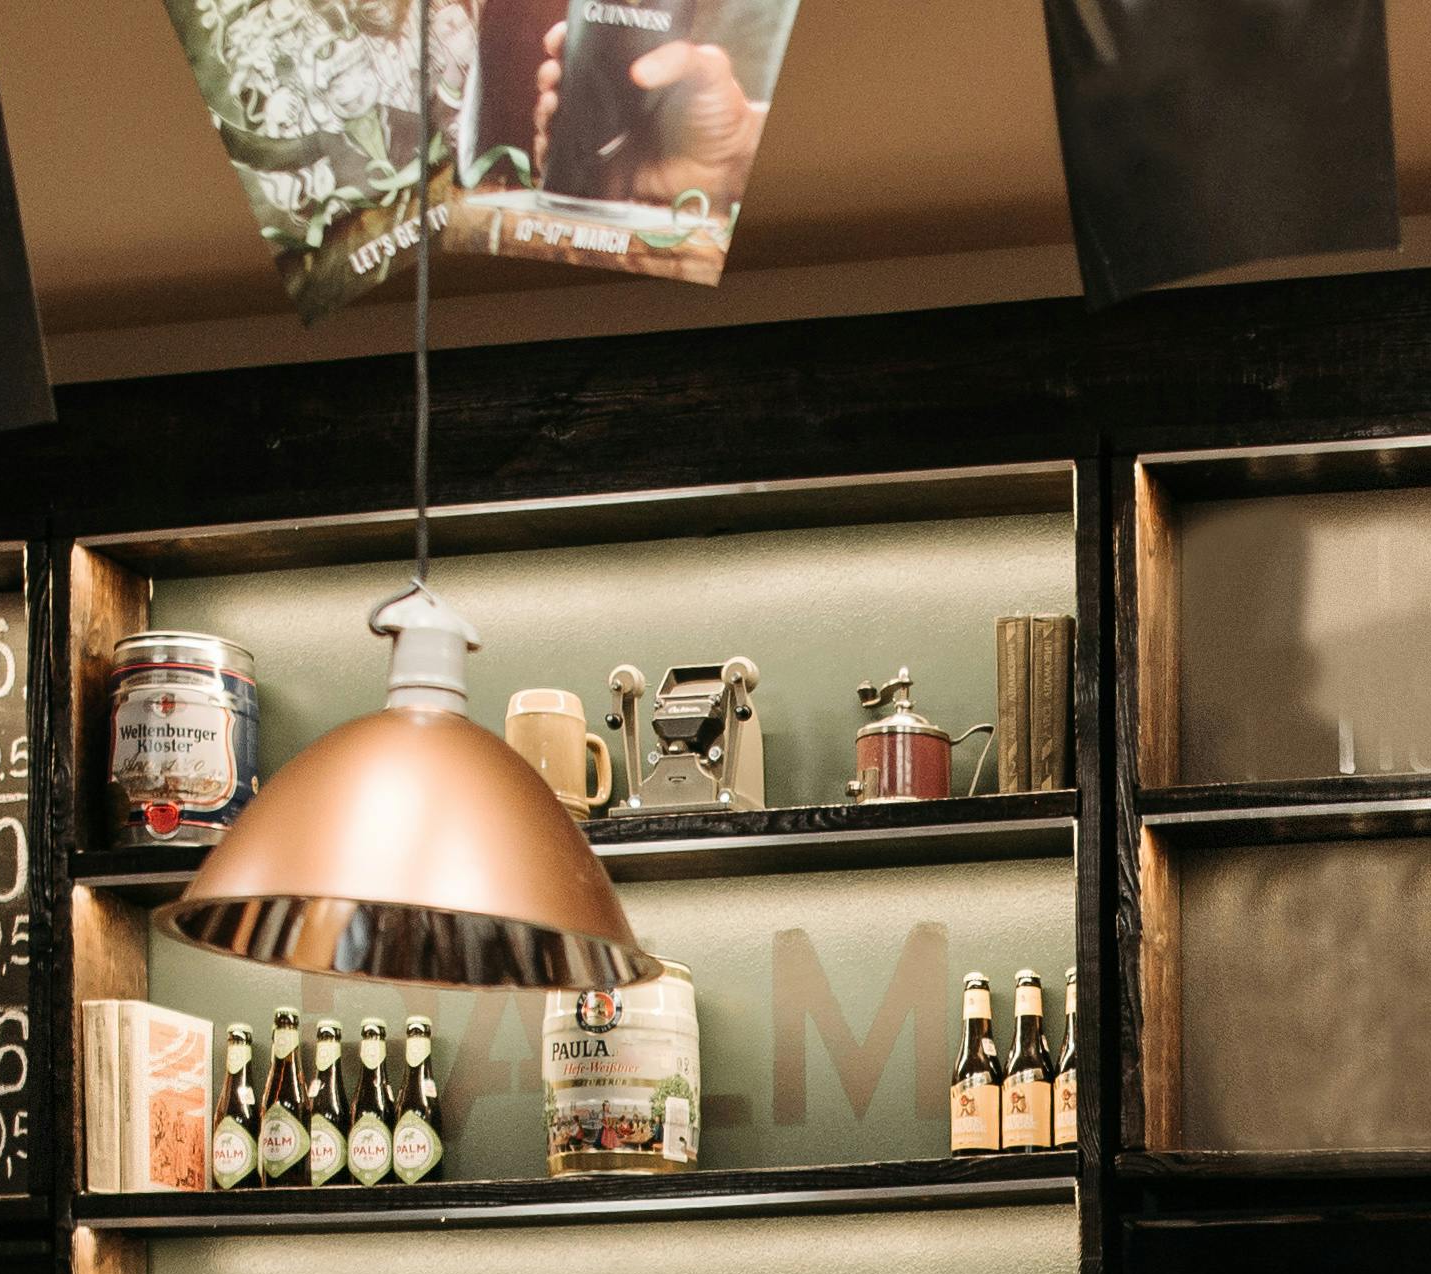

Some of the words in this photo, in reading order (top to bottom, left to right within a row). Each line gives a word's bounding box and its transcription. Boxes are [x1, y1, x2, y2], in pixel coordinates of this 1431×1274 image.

[572, 222, 630, 255] MARCH
[348, 232, 396, 275] LET'S
[392, 217, 420, 249] GE
[119, 723, 218, 744] Weltenburger
[137, 739, 194, 753] Kloster
[551, 1039, 610, 1061] PAULA
[263, 1136, 293, 1147] PALM
[214, 1149, 244, 1160] PALM
[311, 1146, 333, 1157] ALM
[353, 1145, 386, 1155] PALM
[395, 1143, 427, 1154] PALM
